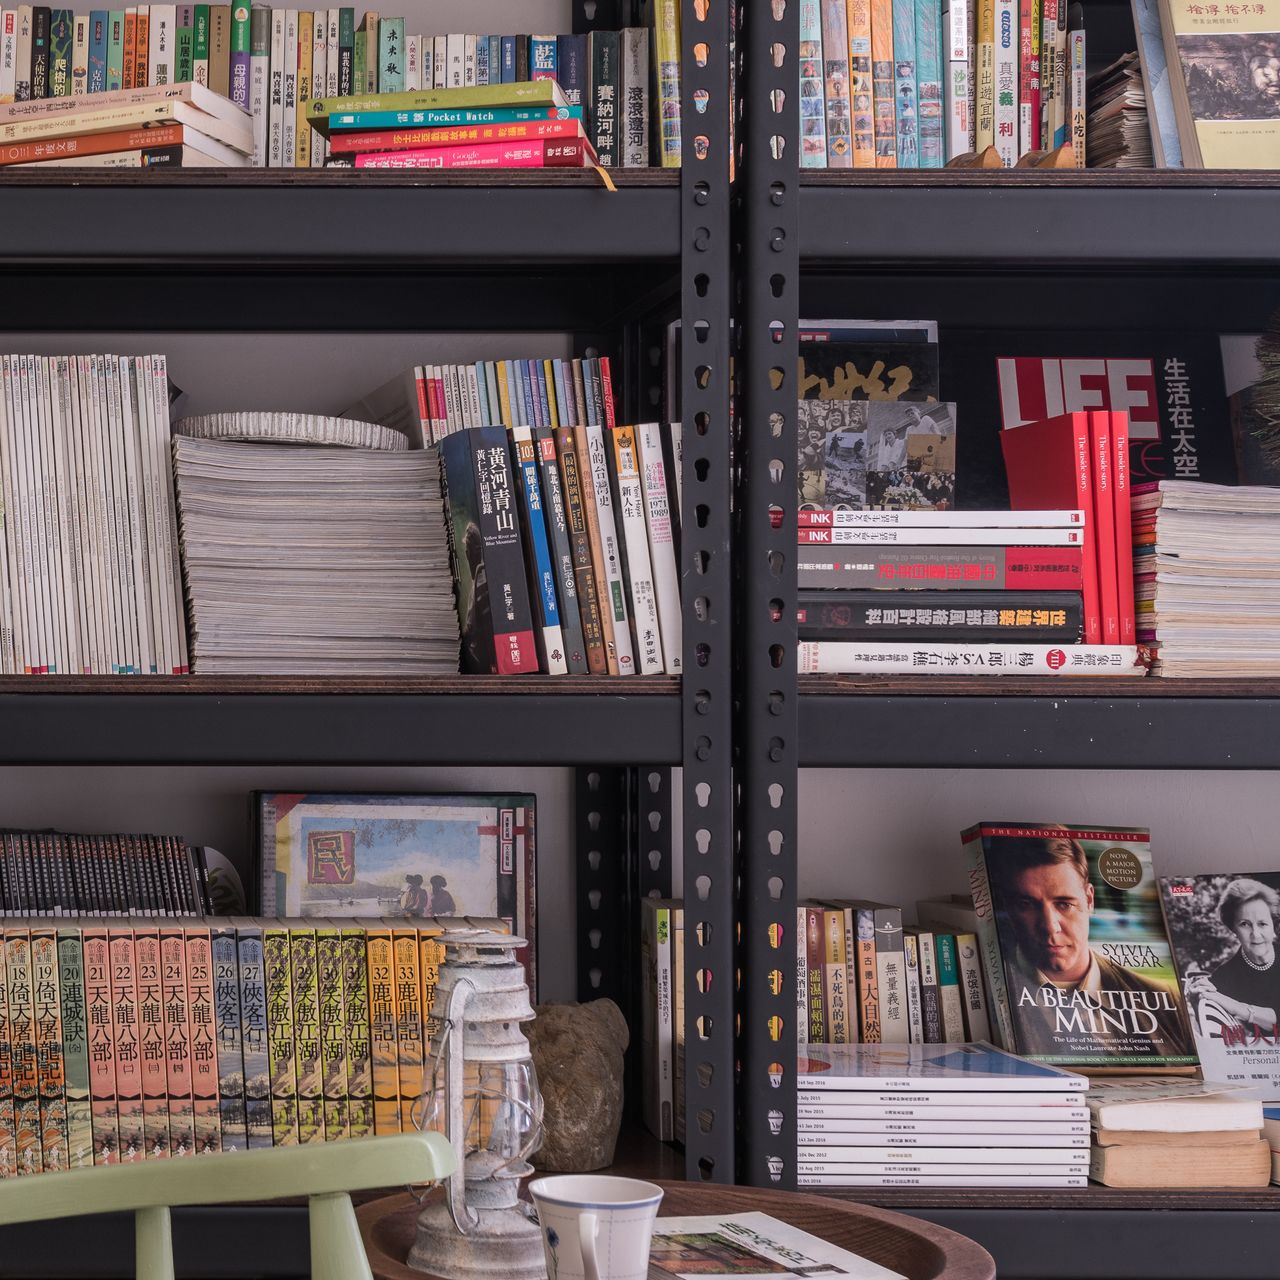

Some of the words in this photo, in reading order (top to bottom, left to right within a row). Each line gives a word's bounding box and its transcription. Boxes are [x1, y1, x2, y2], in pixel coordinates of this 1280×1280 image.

[179, 34, 192, 82] 山居歲月
[385, 29, 401, 75] 未央歌
[953, 70, 967, 98] 沙巴
[1030, 60, 1040, 91] 越南
[979, 70, 993, 132] 出遊宜蘭
[998, 61, 1014, 137] 真愛義大利
[428, 111, 461, 122] Pocket
[466, 111, 494, 121] Watch
[597, 84, 615, 151] 賽納河畔
[628, 86, 645, 148] 滾滾遼河
[1073, 111, 1085, 138] 小吃
[997, 358, 1160, 439] LIFE
[1163, 357, 1201, 477] 生活在太空
[521, 445, 535, 459] 103
[542, 440, 554, 456] 17
[475, 448, 494, 516] 黃仁宇回憶錄
[487, 446, 515, 533] 黃河青山
[621, 485, 635, 518] 新人生
[649, 500, 668, 508] 1971
[650, 509, 669, 518] 1989
[810, 513, 831, 524] INK
[808, 531, 829, 542] INK
[991, 828, 1011, 836] THE
[1017, 829, 1071, 838] NATIONAL
[1077, 832, 1139, 841] BESTSELLER
[1109, 852, 1128, 860] NOW
[1102, 943, 1155, 958] SYLVIA
[1109, 954, 1164, 969] NASAR
[13, 966, 26, 981] 18
[38, 966, 52, 980] 19
[63, 966, 79, 981] 20
[90, 966, 105, 981] 21
[115, 966, 131, 981] 22
[141, 965, 157, 980] 23
[166, 965, 181, 980] 24
[191, 965, 207, 980] 25
[218, 965, 233, 979] 26
[244, 966, 259, 981] 27
[271, 966, 286, 980] 28
[297, 966, 312, 980] 29
[373, 966, 390, 981] 32
[399, 966, 415, 981] 33
[885, 962, 901, 1021] 無量義經
[1019, 986, 1037, 1008] A
[1042, 987, 1178, 1011] BEAUTIFUL
[62, 983, 84, 1043] 連城訣
[88, 985, 112, 1063] 天龍八部
[114, 984, 138, 1063] 天龍八部
[140, 984, 164, 1062] 天龍八部
[164, 984, 189, 1062] 天龍八部
[190, 984, 214, 1062] 天龍八部
[216, 981, 238, 1042] 俠客行
[242, 982, 263, 1043] 俠客行
[269, 984, 292, 1061] 笑傲江湖
[295, 983, 318, 1061] 笑傲江湖
[371, 981, 394, 1043] 鹿鼎記
[397, 981, 420, 1042] 鹿鼎記
[1054, 1007, 1159, 1035] MIND
[10, 981, 35, 1082] 倚天屠龍記
[36, 981, 61, 1081] 倚天屠龍記
[1066, 1036, 1078, 1044] Life
[1129, 1037, 1151, 1045] Genius
[1118, 1045, 1133, 1053] John
[1242, 1056, 1280, 1065] Personal
